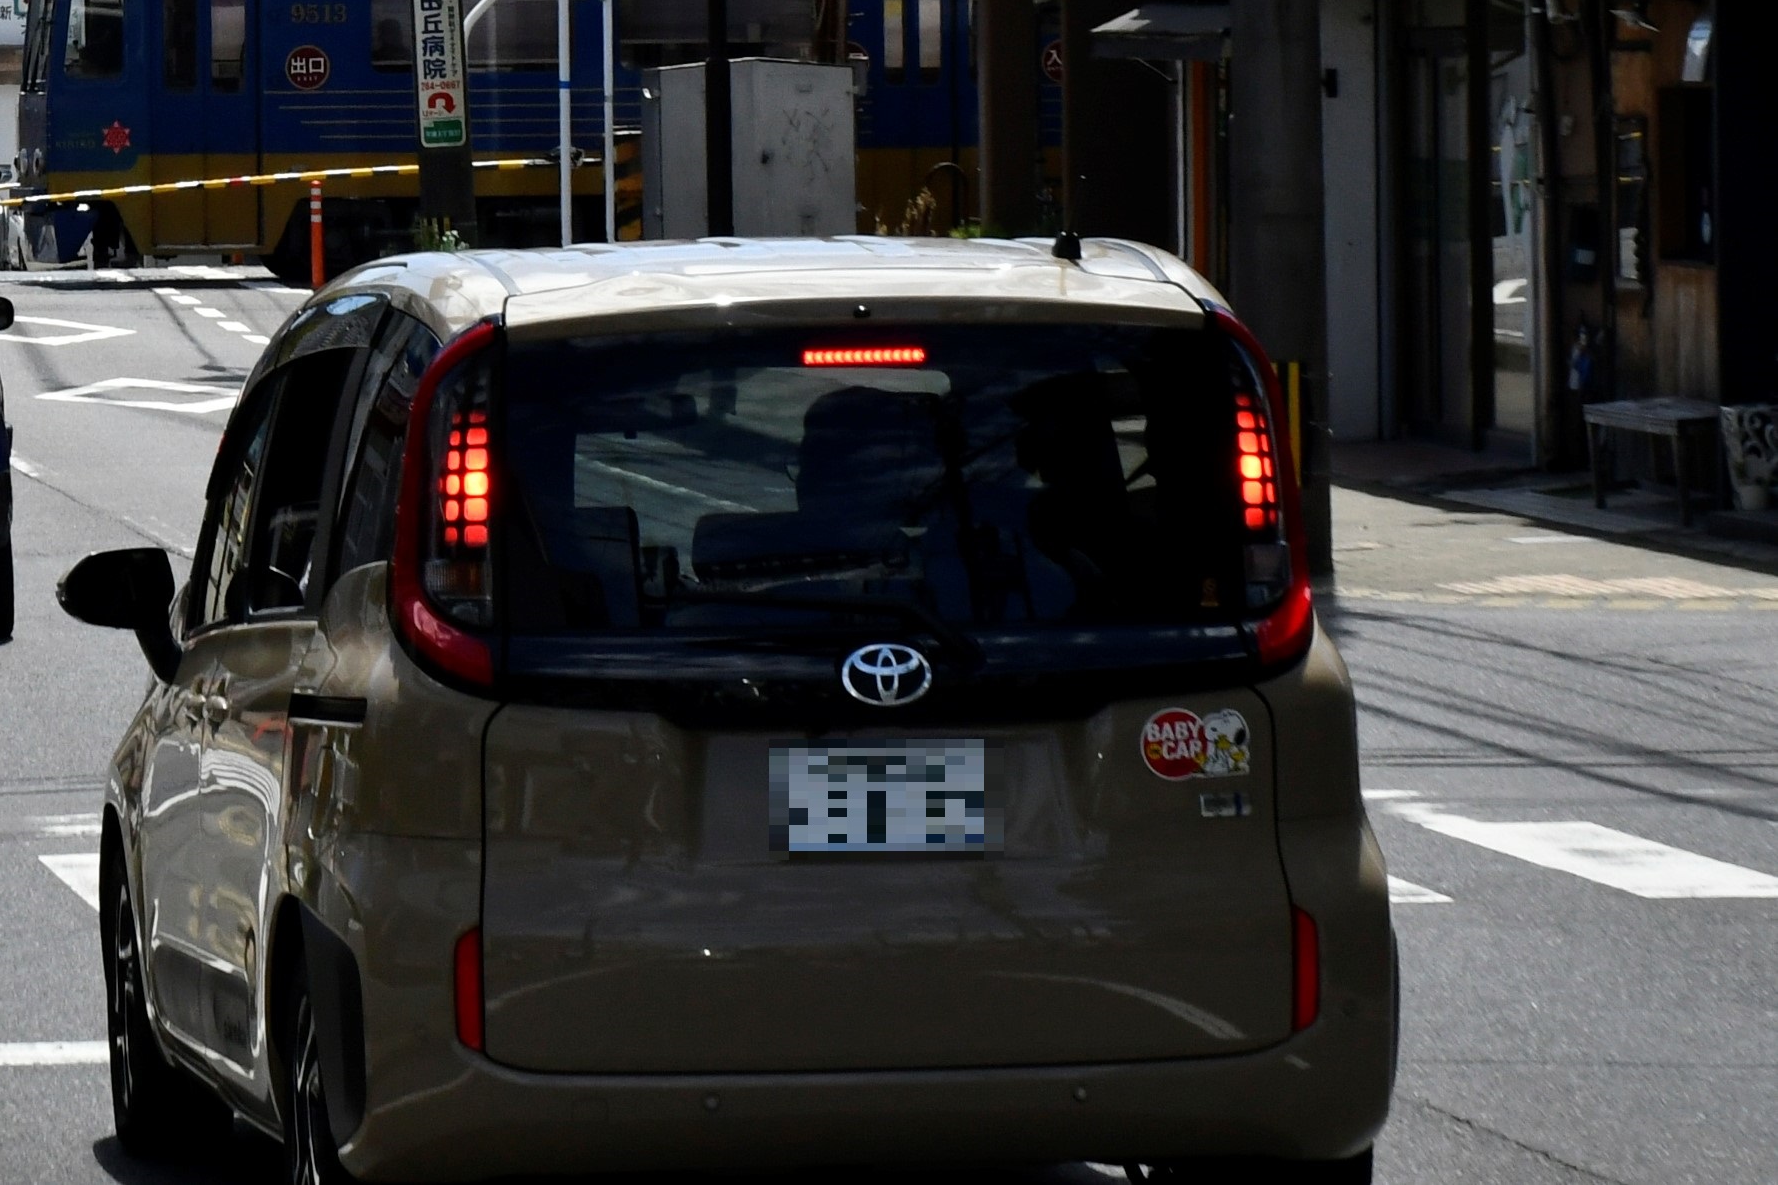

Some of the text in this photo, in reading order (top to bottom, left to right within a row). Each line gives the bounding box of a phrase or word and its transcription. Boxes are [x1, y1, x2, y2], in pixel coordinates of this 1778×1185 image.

[290, 2, 348, 24] 9513
[290, 56, 325, 75] 出口
[1145, 720, 1203, 742] BABY
[1162, 739, 1203, 760] CAR
